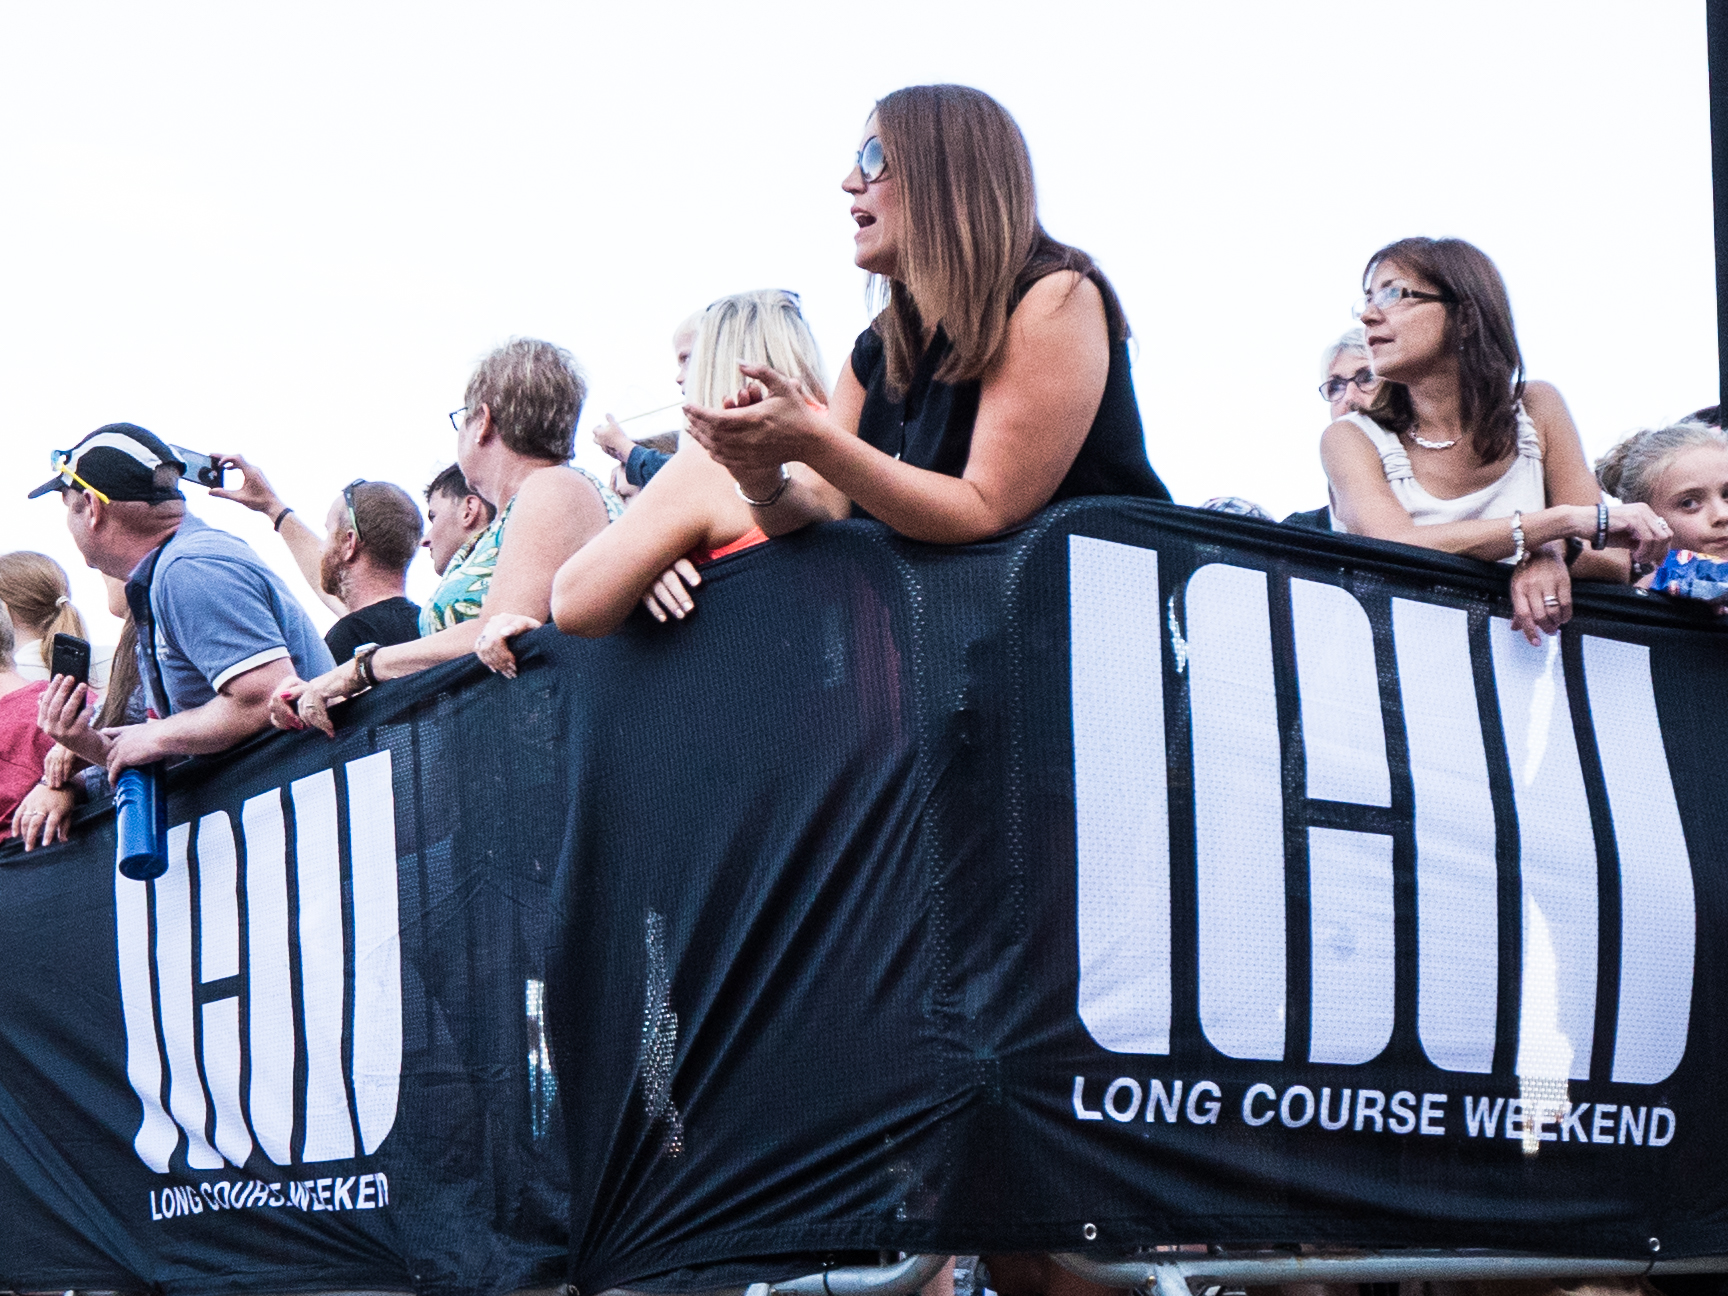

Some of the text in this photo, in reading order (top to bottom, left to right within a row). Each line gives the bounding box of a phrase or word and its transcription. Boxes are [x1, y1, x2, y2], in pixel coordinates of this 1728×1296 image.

[1073, 1075, 1677, 1148] LONG COURSE WEEKEND
[150, 1185, 204, 1220] LONG
